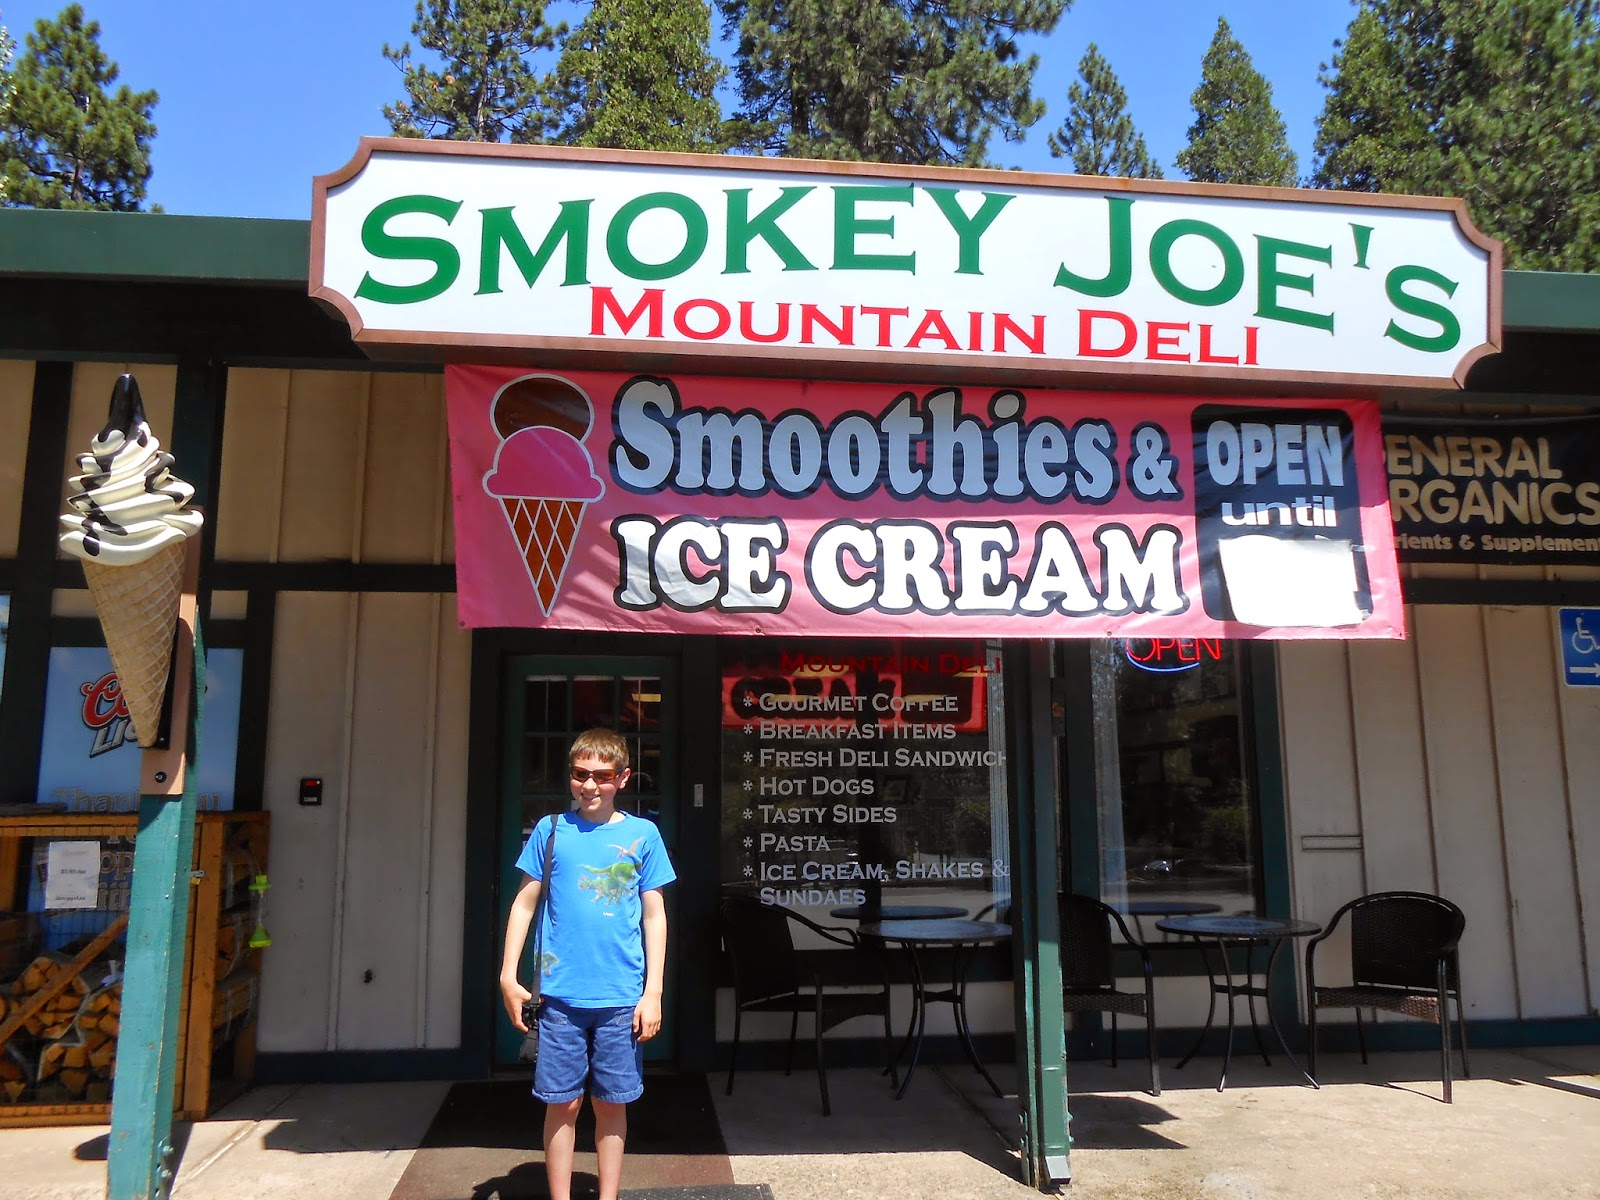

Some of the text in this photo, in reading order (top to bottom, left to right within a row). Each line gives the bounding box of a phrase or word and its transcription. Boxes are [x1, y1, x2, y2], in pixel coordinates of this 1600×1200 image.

[354, 183, 1461, 353] SMOKEY JOE'S
[589, 286, 1260, 367] MOUNTAIN DELI
[610, 377, 1183, 503] Smoothies &
[1206, 420, 1344, 487] OPEN
[1382, 434, 1563, 479] ENERAL
[1221, 496, 1337, 527] until
[1389, 479, 1600, 526] RGANICS
[1394, 533, 1600, 552] rients & Supplemen
[612, 515, 1188, 616] ICE CREAM
[1125, 638, 1222, 661] OPEN
[780, 651, 1001, 674] MOUNTAIN DELI
[759, 693, 867, 712] GOURMET
[872, 694, 959, 712] COFFEE
[759, 721, 957, 740] BREAKFAST ITEMS
[760, 748, 833, 768] FRESH
[839, 748, 889, 768] DELI
[760, 776, 875, 796] HOT DOGS
[758, 804, 897, 824] TASTY SIDES
[760, 833, 831, 852] PASTA
[760, 861, 797, 880] ICE
[896, 859, 984, 880] SHAKES
[992, 859, 1010, 878] &
[760, 887, 866, 906] SUNDAES
